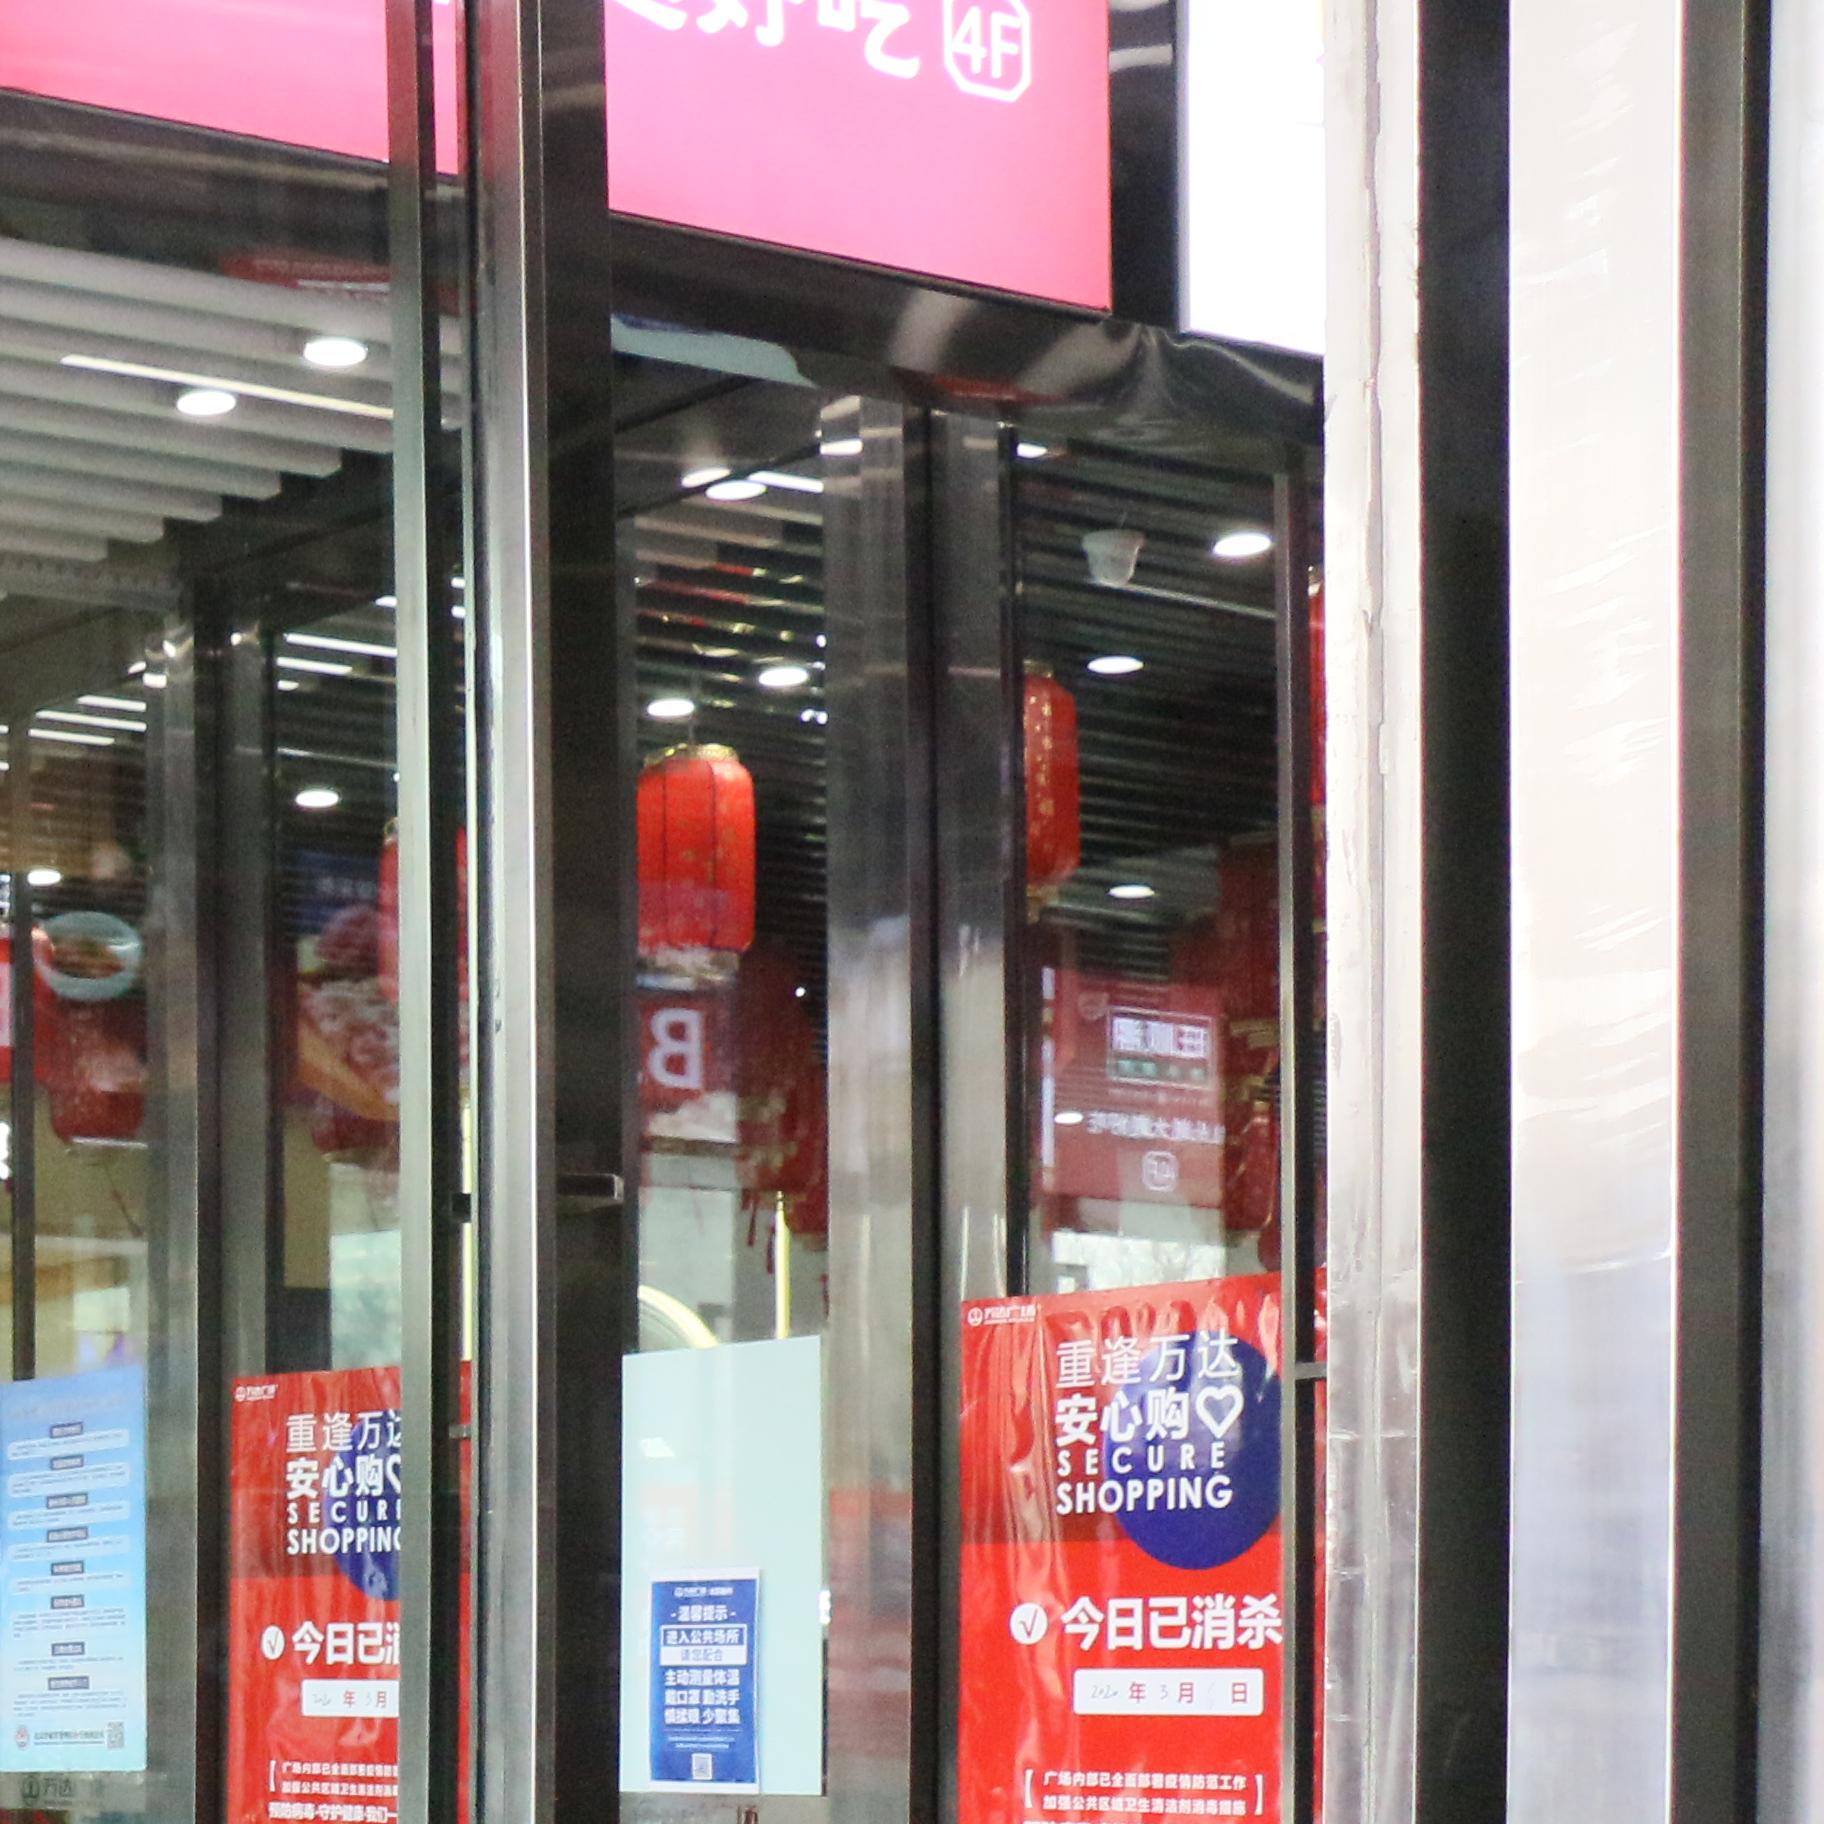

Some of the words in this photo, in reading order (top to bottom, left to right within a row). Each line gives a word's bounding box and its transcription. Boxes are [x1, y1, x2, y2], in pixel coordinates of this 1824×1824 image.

[1055, 1328, 1241, 1389] 重逢万达
[1055, 1387, 1190, 1448] 安心购
[286, 1453, 384, 1500] 安心购
[1057, 1442, 1226, 1477] SECURE
[1056, 1475, 1233, 1515] SHOPPING
[666, 1628, 740, 1645] 进入公共场所
[1061, 1593, 1284, 1651] 今日已消杀
